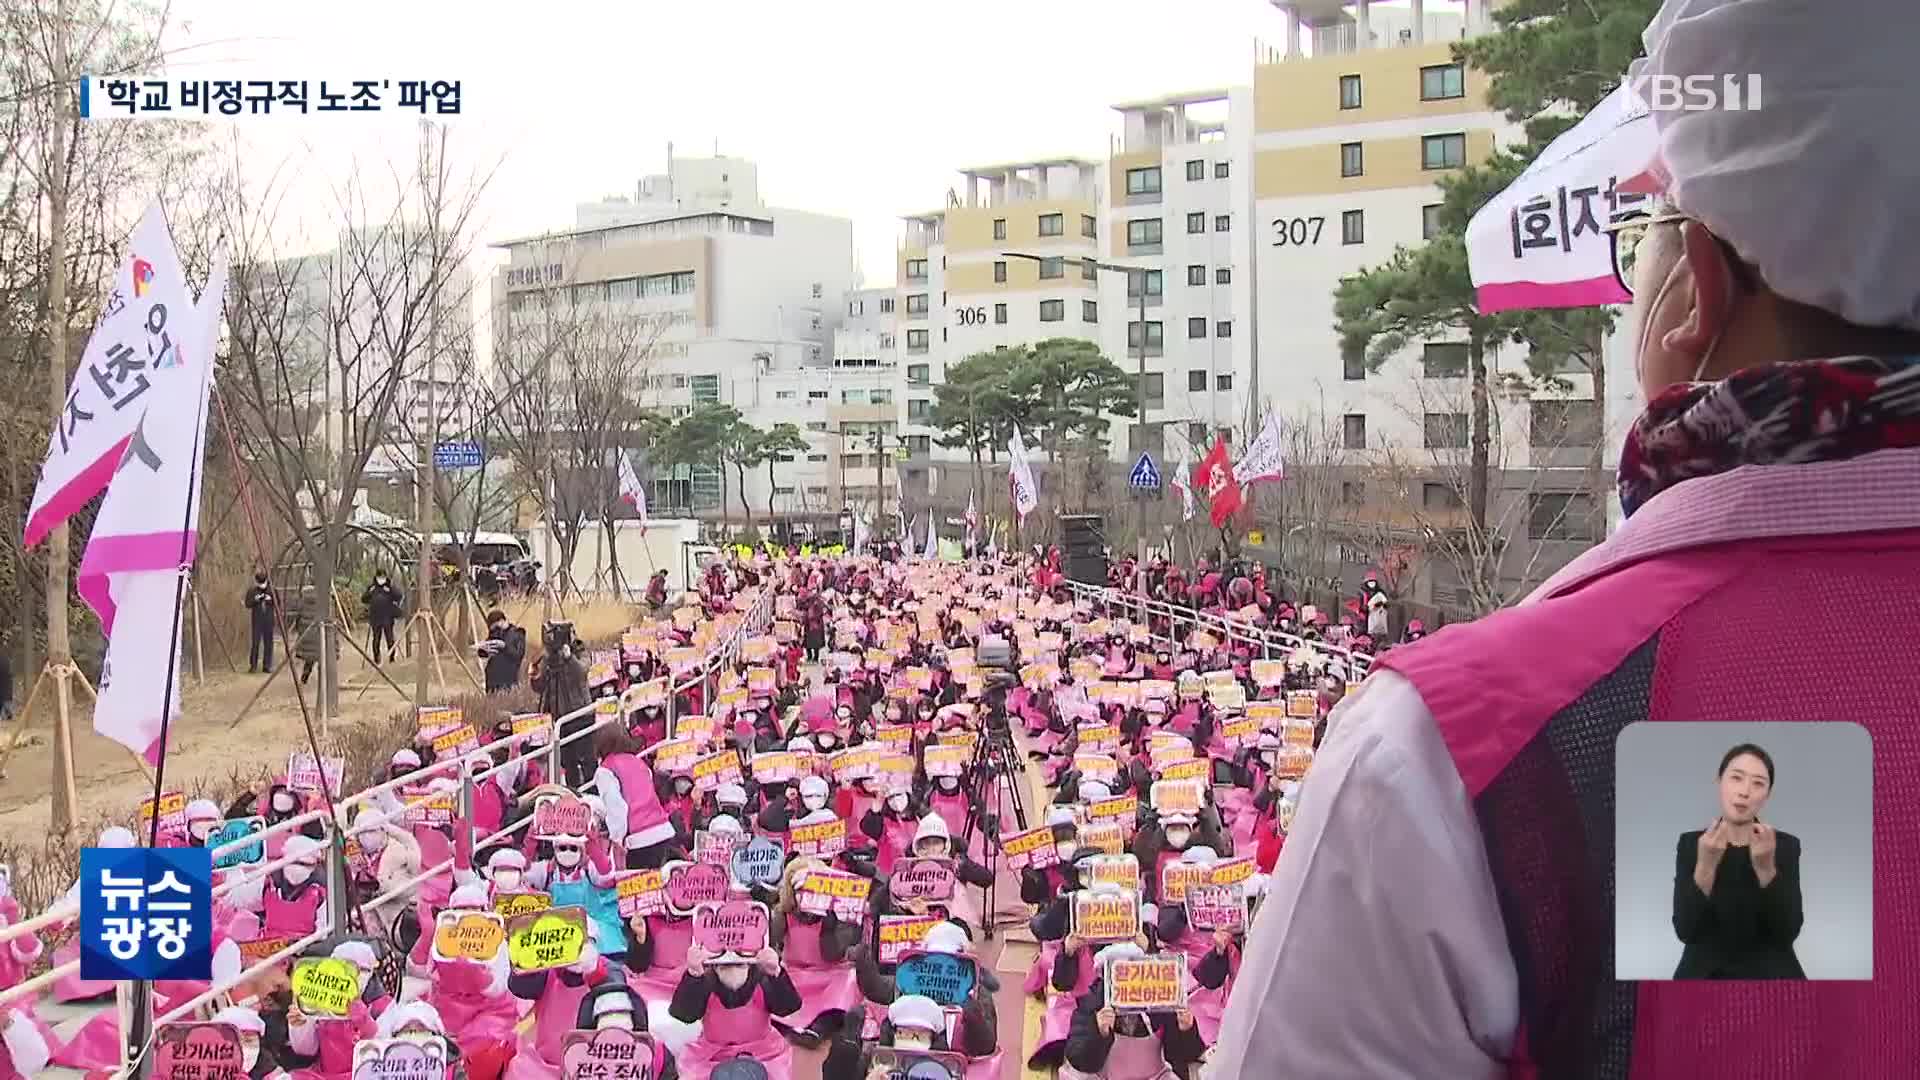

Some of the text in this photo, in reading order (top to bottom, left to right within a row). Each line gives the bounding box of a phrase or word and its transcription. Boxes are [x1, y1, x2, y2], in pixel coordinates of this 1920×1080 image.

[1271, 216, 1325, 246] 307
[956, 306, 986, 326] 306
[703, 913, 760, 929] 대체인력
[519, 927, 574, 948] 휴게공간
[1114, 961, 1176, 981] 환기시설
[172, 1042, 234, 1060] 환기시설
